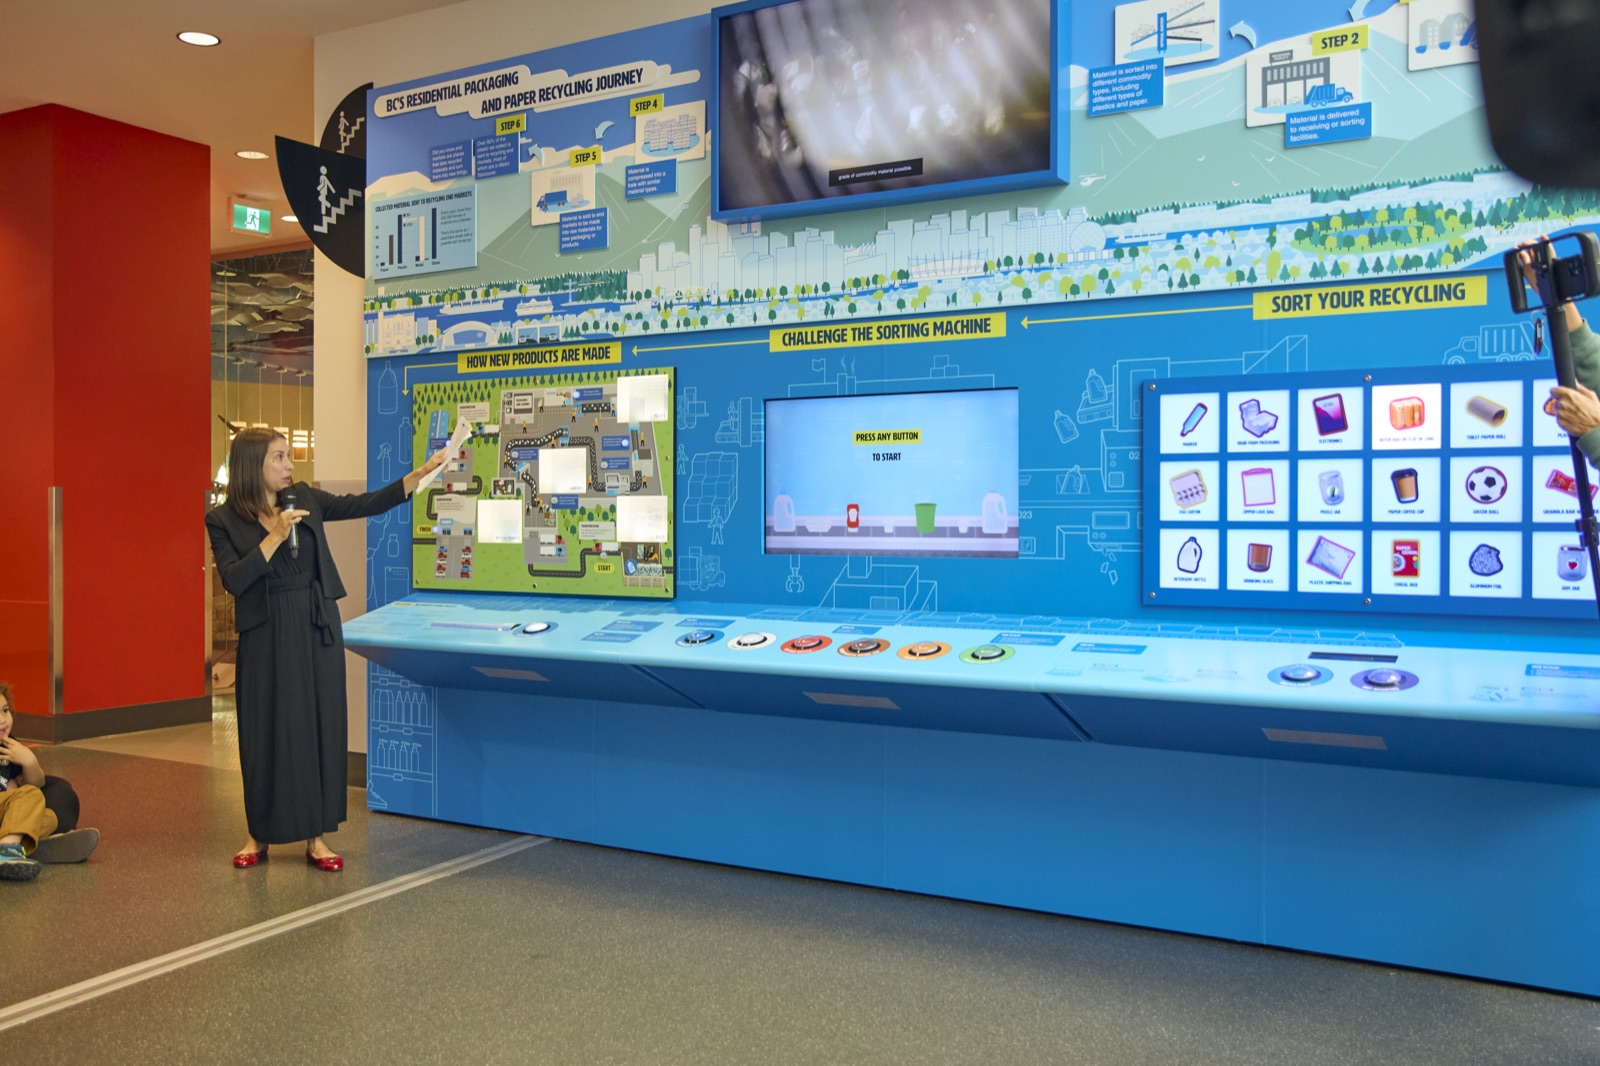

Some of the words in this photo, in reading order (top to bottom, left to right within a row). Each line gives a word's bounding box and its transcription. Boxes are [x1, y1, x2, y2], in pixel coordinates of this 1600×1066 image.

[1321, 34, 1348, 49] STEP
[1351, 32, 1359, 44] 2
[1092, 69, 1117, 79] Material
[1124, 65, 1144, 74] sorted
[1092, 77, 1117, 87] different
[1117, 73, 1152, 83] commodity
[1111, 83, 1139, 92] including
[386, 97, 404, 112] BC'S
[406, 84, 462, 108] RESIDENTIAL
[464, 71, 519, 96] PACKAGING
[481, 99, 501, 114] AND
[504, 91, 536, 110] PAPER
[539, 78, 593, 102] RECYCLING
[595, 67, 644, 92] JOURNEY
[1092, 93, 1117, 103] different
[1118, 91, 1135, 100] types
[635, 101, 651, 112] STEP
[652, 99, 658, 108] 4
[1092, 103, 1115, 113] plastics
[1116, 100, 1128, 108] and
[1129, 98, 1149, 107] paper.
[1290, 114, 1318, 124] Material
[1326, 109, 1359, 120] delivered
[500, 120, 515, 132] STEP
[516, 119, 521, 128] 6
[1298, 122, 1330, 132] receiving
[1340, 117, 1365, 127] sorting
[575, 153, 590, 163] STEP
[591, 151, 597, 160] 5
[375, 204, 393, 212] COLLECTED
[393, 201, 410, 209] MATERIAL
[425, 195, 445, 204] RECYCLING
[454, 190, 472, 200] MARKETS
[1271, 293, 1313, 313] SORT
[1317, 289, 1365, 310] YOUR
[1369, 282, 1466, 306] RECYCLING
[782, 328, 848, 347] CHALLENGE
[850, 326, 873, 342] THE
[876, 322, 929, 340] SORTING
[932, 317, 991, 336] MACHINE
[466, 354, 488, 369] HOW
[489, 353, 510, 368] NEW
[512, 349, 558, 366] PRODUCTS
[561, 348, 580, 362] ARE
[582, 345, 611, 361] MADE
[856, 433, 876, 441] PRESS
[877, 432, 892, 441] ANY
[892, 431, 919, 440] BUTTON
[872, 453, 880, 461] TO
[881, 452, 902, 462] START
